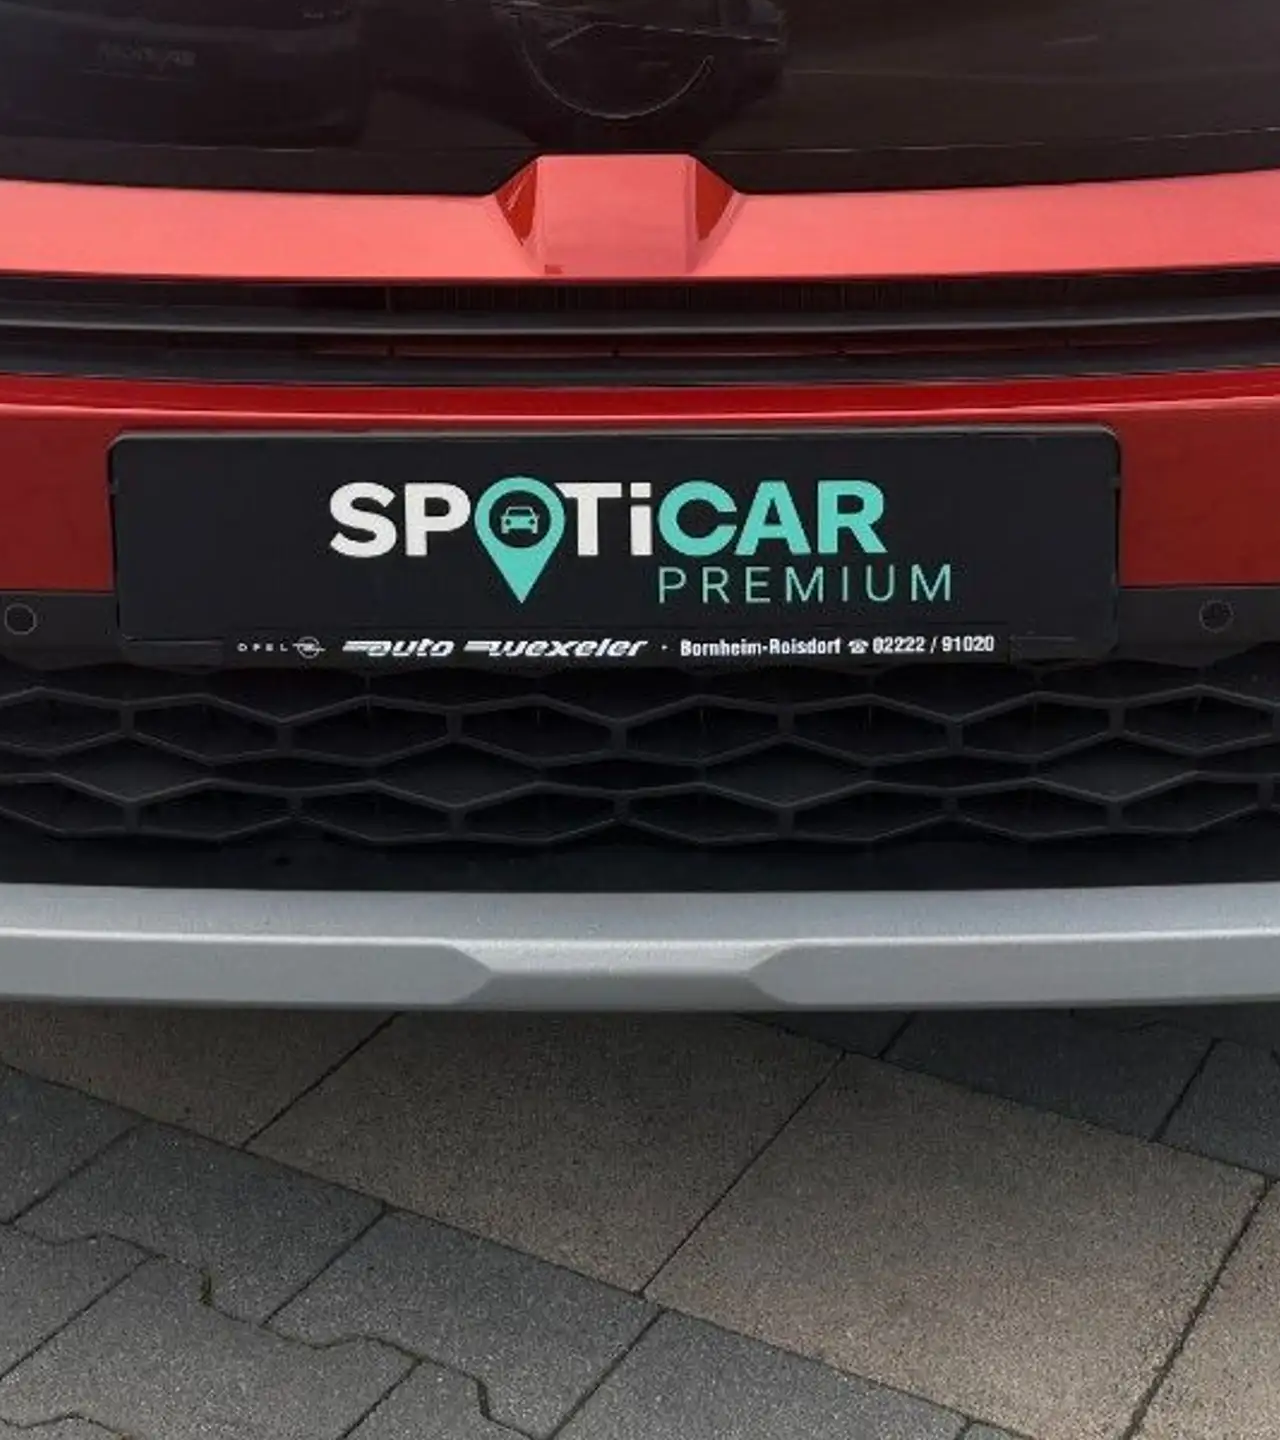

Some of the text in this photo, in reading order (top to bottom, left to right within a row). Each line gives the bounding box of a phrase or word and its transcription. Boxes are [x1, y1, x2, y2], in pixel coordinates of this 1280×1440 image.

[658, 564, 953, 604] PREMIUM
[680, 638, 841, 657] Bornheim-Roisdorf
[872, 636, 926, 654] 02222
[941, 635, 995, 653] 91020
